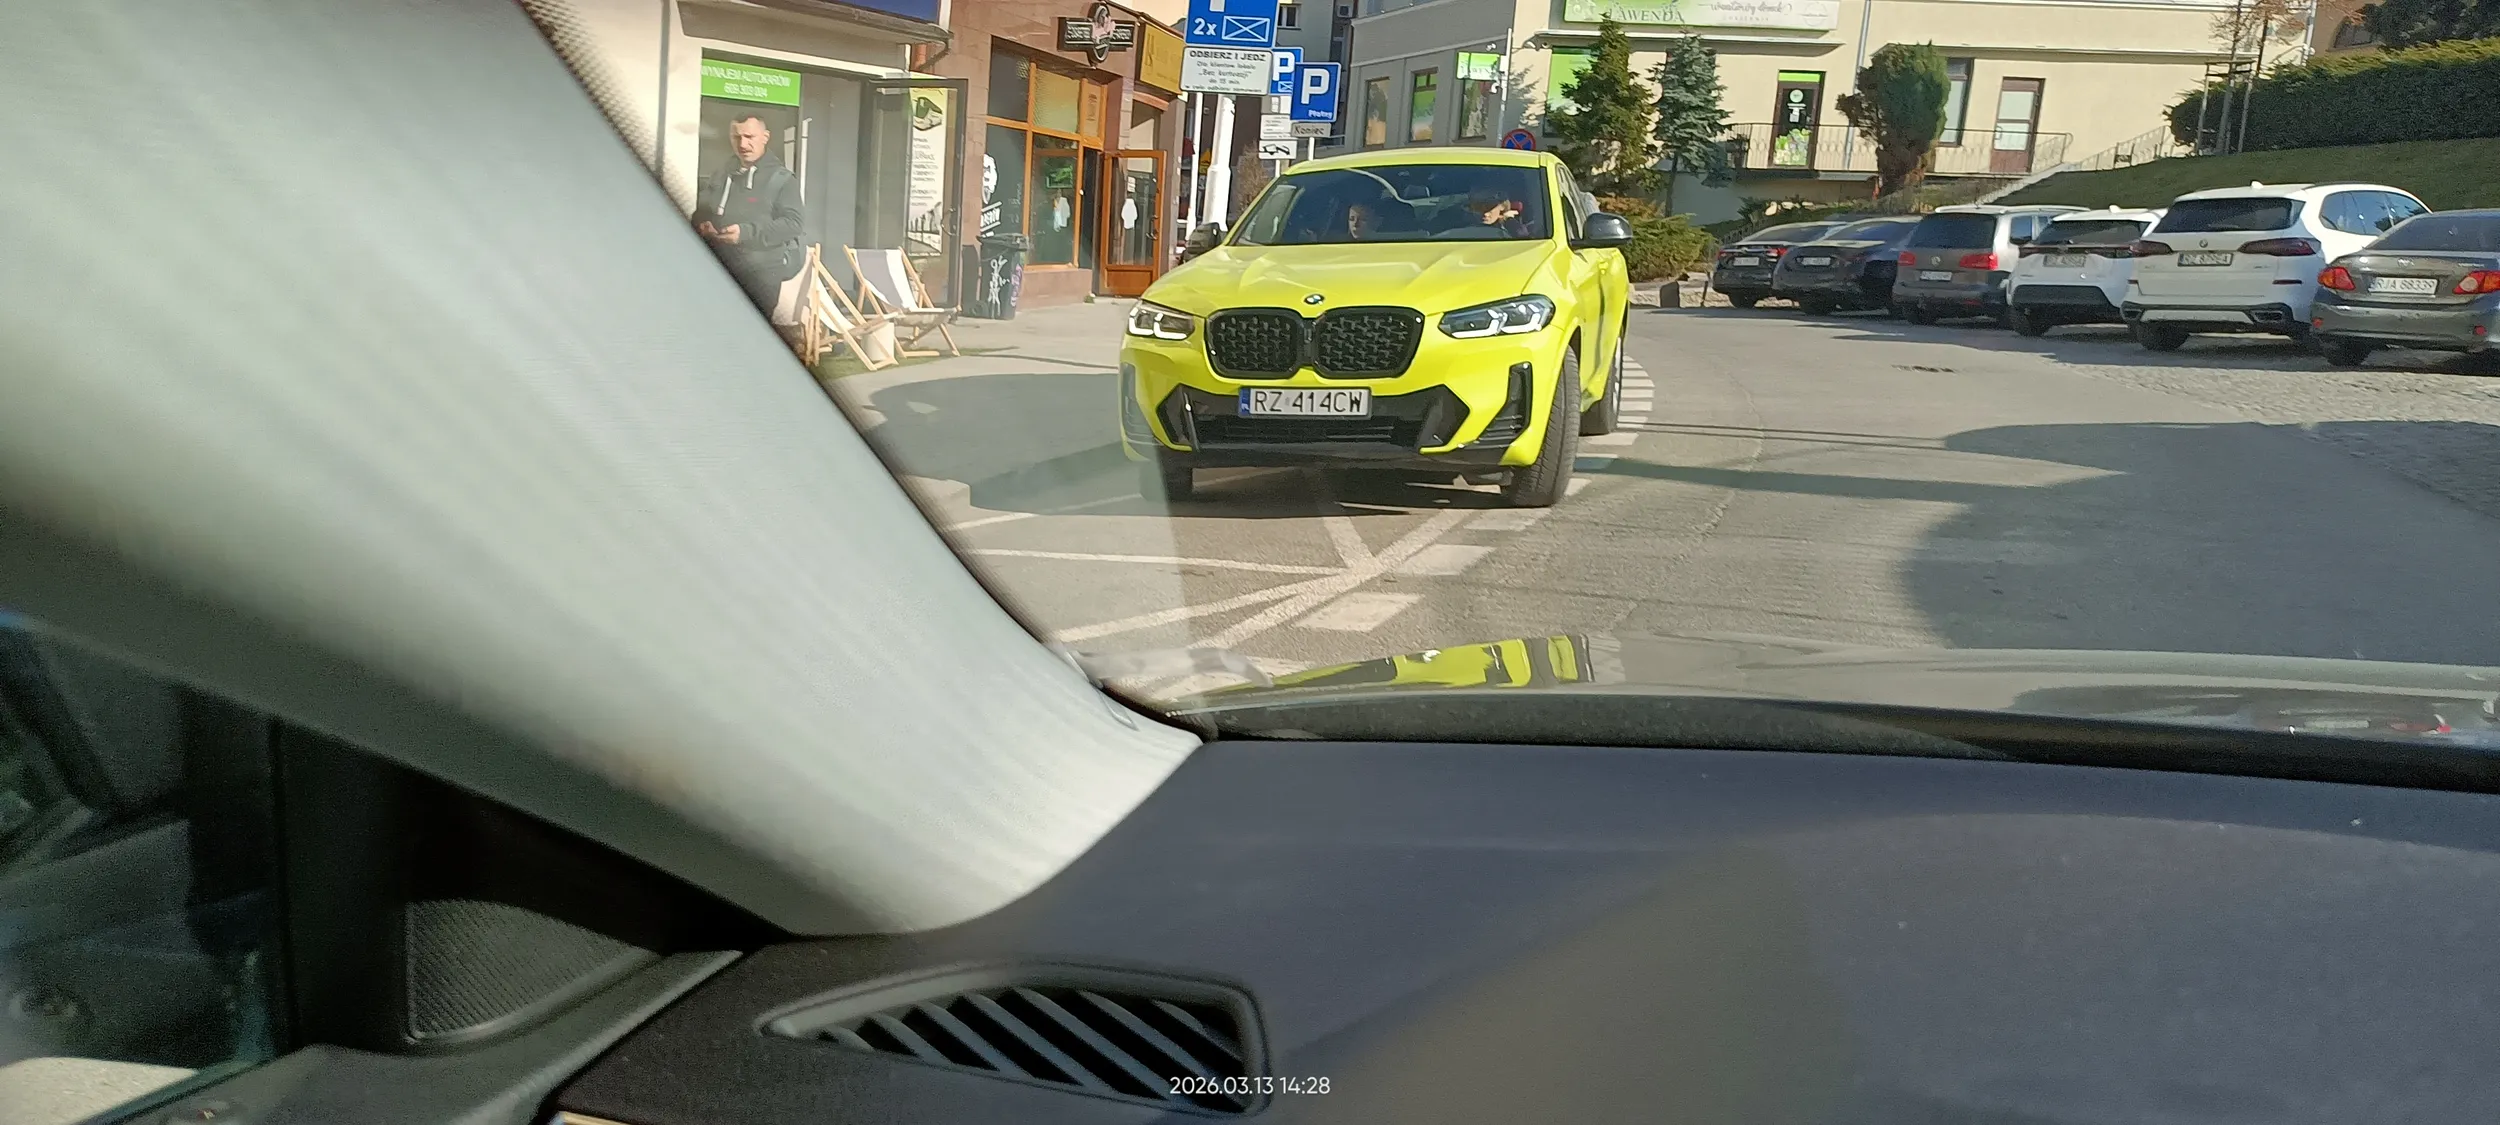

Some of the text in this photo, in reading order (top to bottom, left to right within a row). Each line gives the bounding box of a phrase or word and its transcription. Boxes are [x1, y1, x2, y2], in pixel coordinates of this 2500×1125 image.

[1193, 18, 1217, 36] 2x
[1190, 50, 1232, 60] ODBIERZ
[1234, 52, 1239, 60] I
[1272, 51, 1295, 82] P
[1300, 68, 1330, 105] P
[2376, 278, 2397, 290] RJA
[1254, 390, 1362, 413] RZ 414CW
